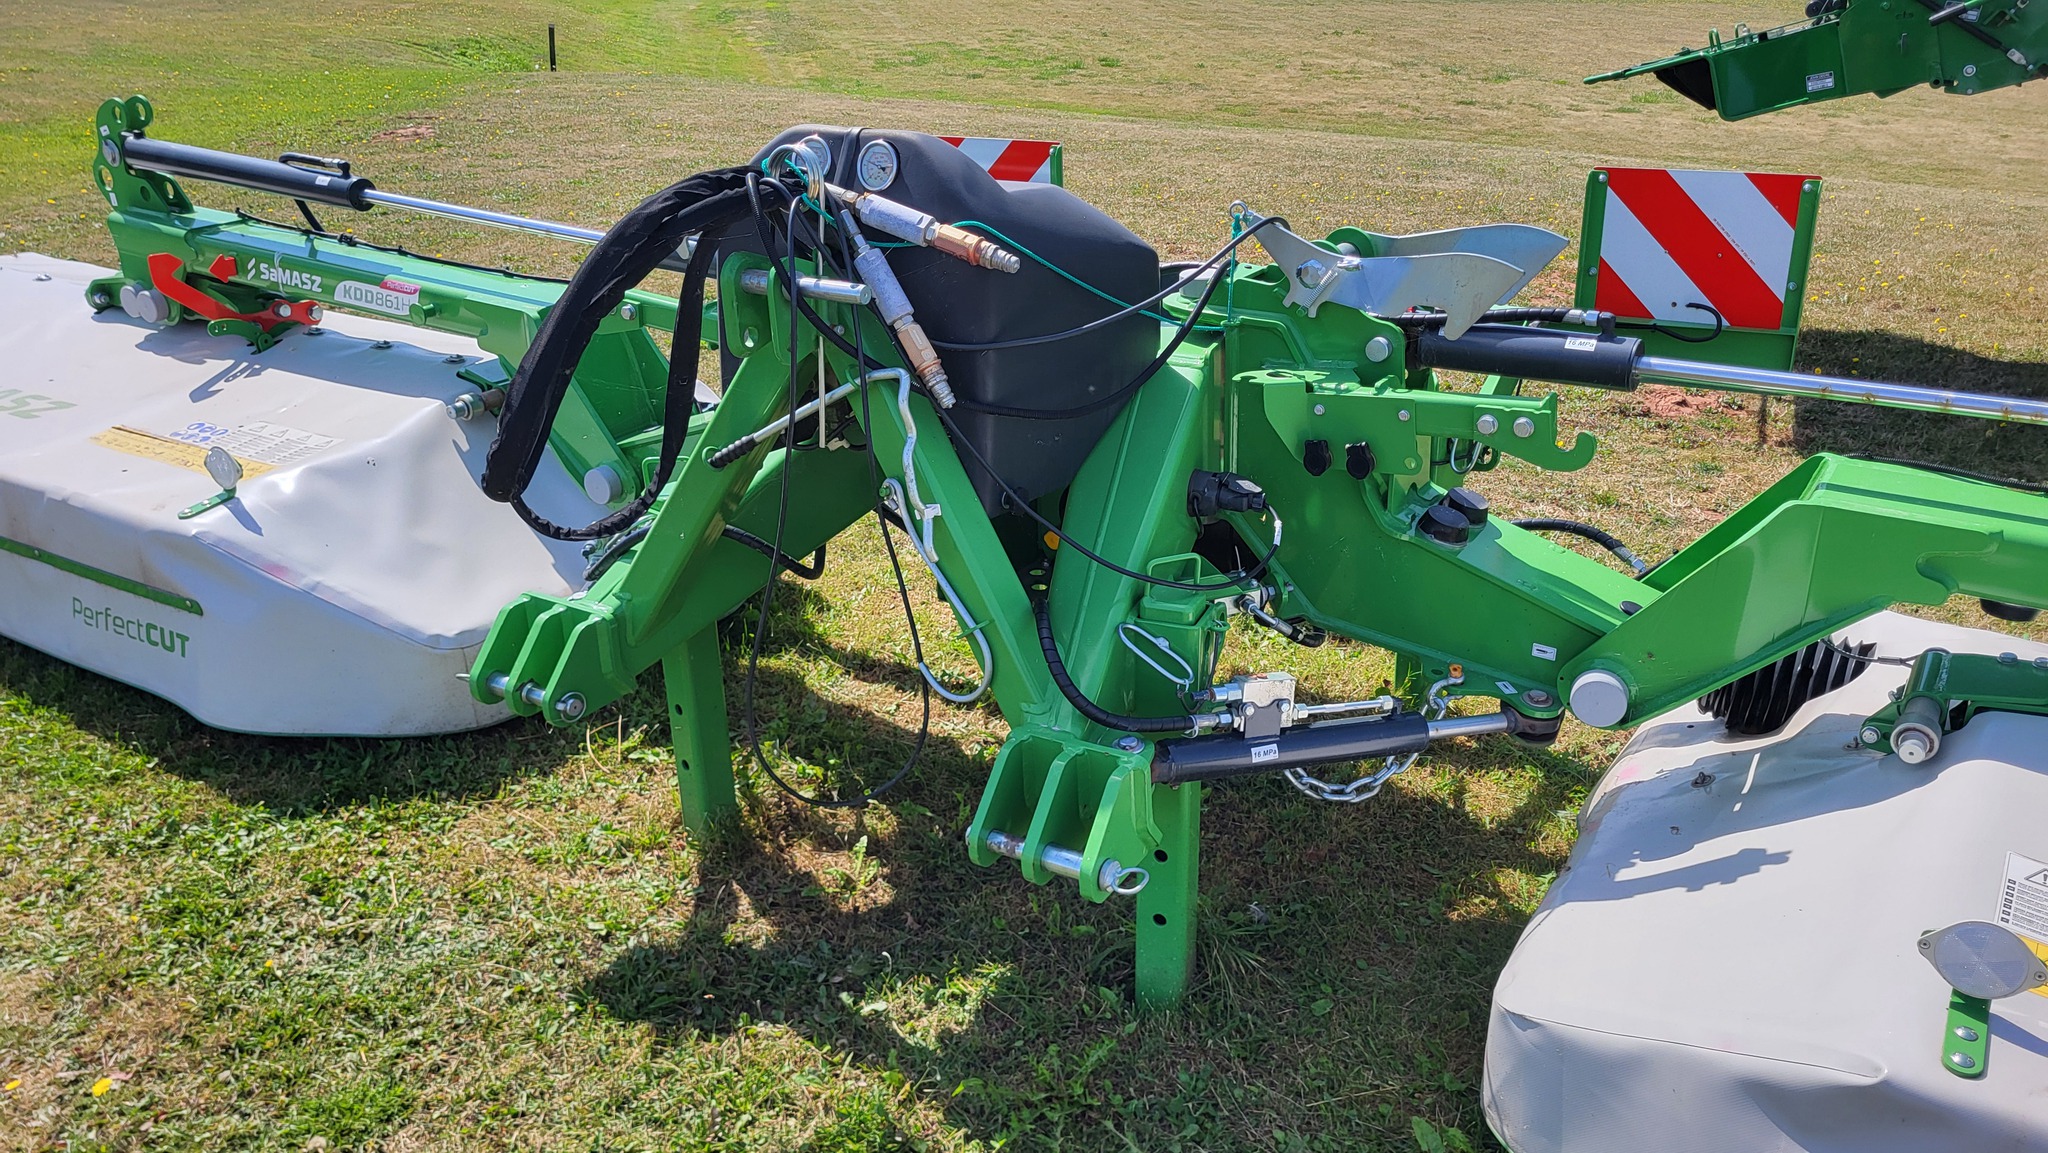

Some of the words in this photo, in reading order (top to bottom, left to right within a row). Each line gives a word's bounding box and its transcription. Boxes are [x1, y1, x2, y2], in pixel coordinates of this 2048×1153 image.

[260, 262, 323, 293] SaMASZ
[343, 284, 411, 312] KDD861H
[1578, 340, 1595, 348] MPa
[72, 596, 190, 658] PerfectCUT
[1262, 748, 1277, 757] MPa
